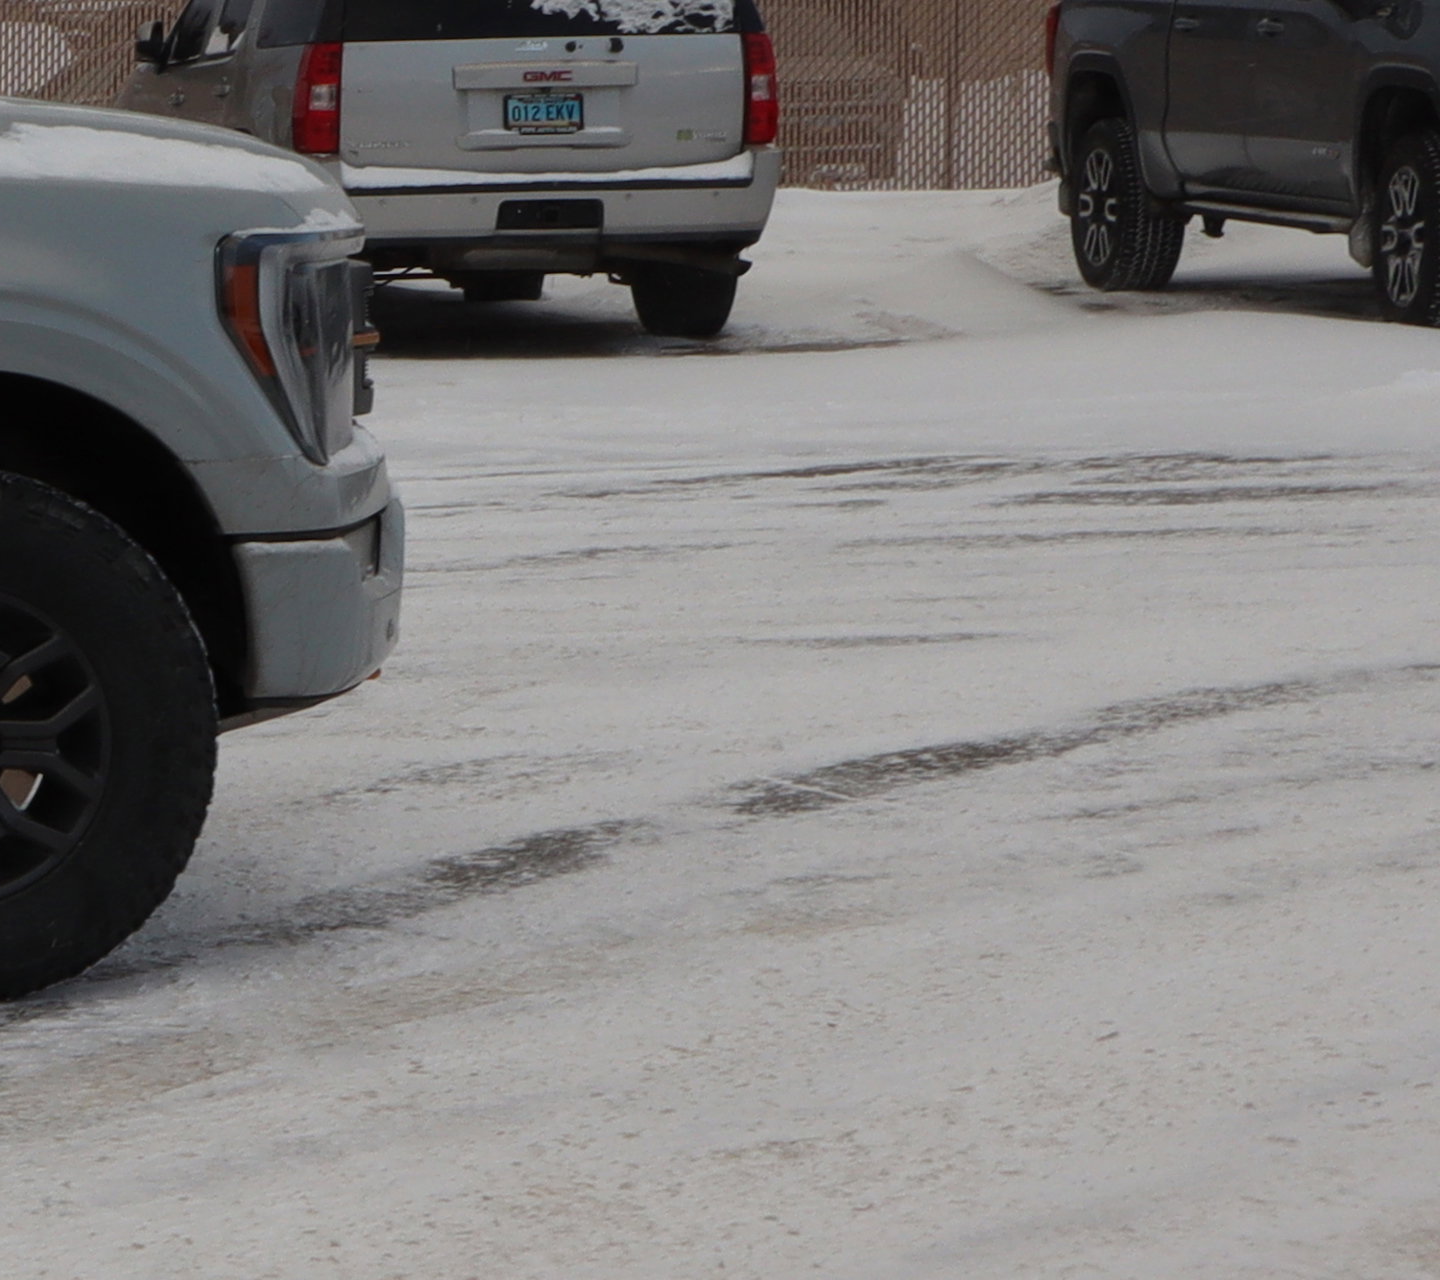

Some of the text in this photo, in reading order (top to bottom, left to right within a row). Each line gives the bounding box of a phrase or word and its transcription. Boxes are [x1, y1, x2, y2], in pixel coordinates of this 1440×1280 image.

[522, 70, 573, 82] GMC
[511, 103, 576, 122] 012 EKV
